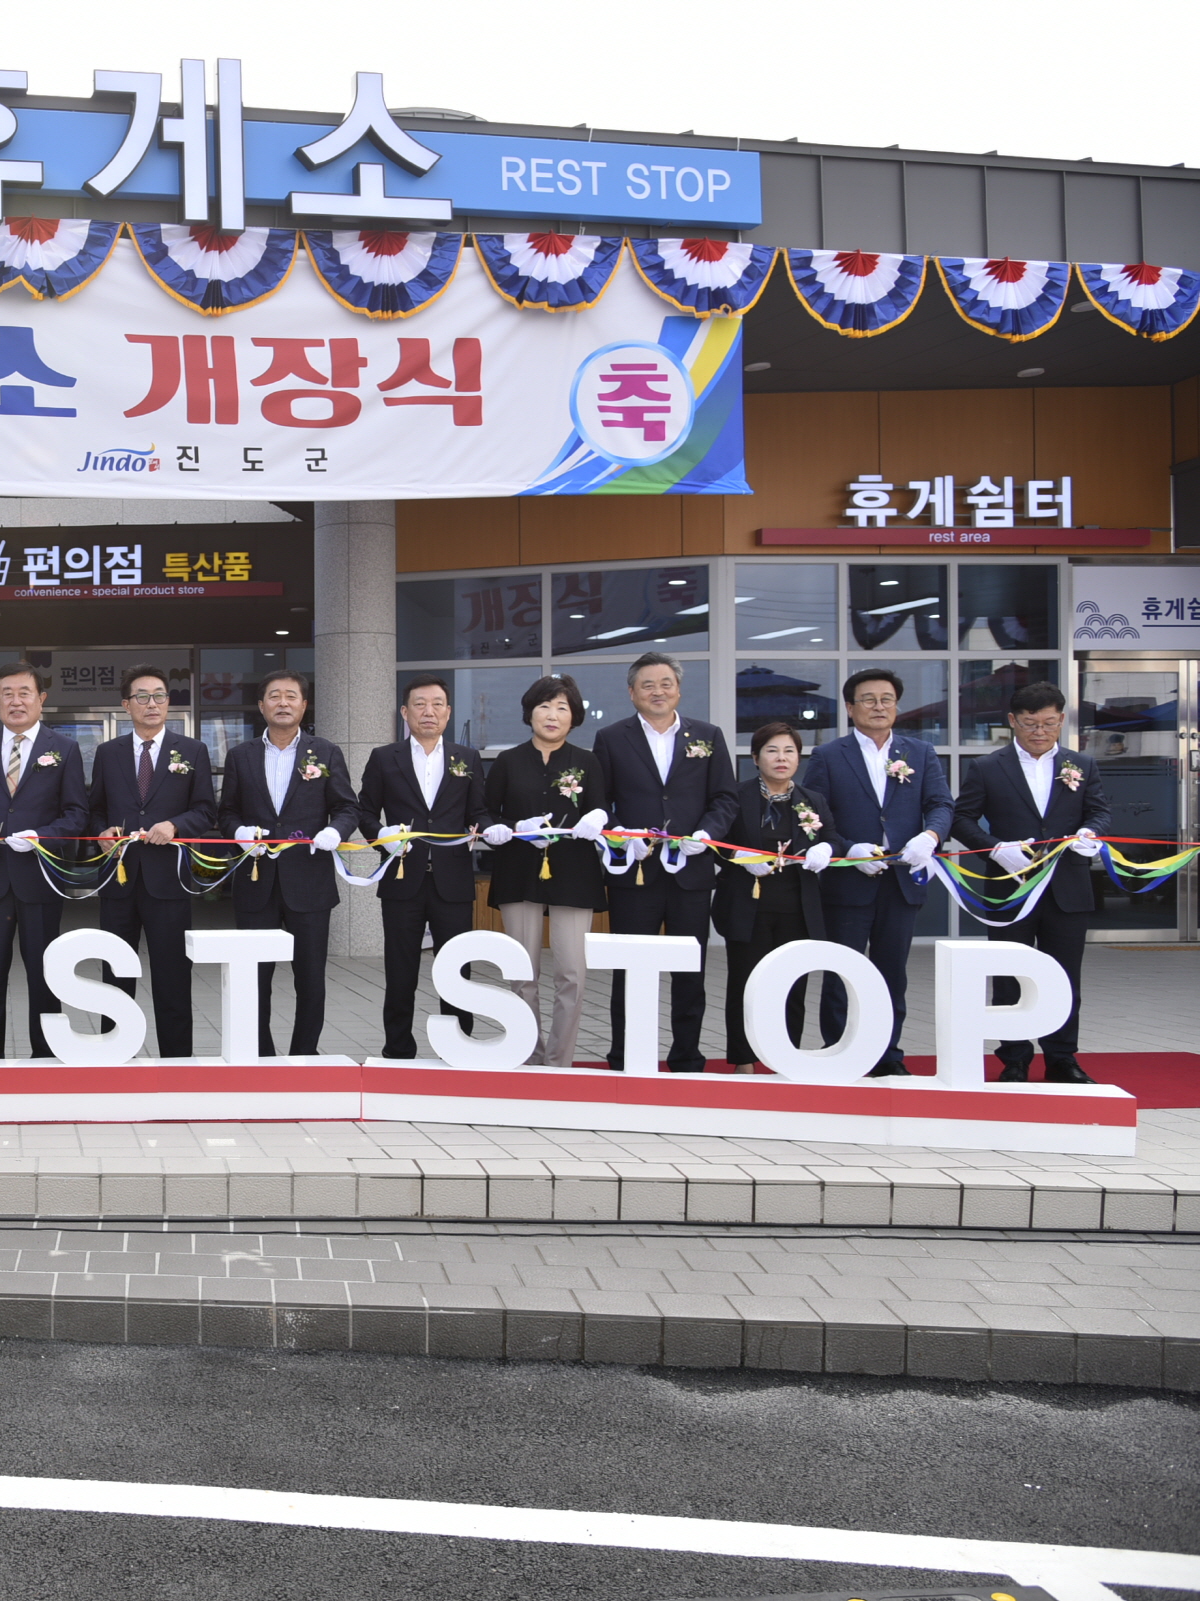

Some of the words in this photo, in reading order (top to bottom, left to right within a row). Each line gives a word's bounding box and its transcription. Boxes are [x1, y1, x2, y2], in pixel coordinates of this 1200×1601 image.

[501, 156, 607, 196] REST
[626, 163, 731, 203] STOP
[123, 334, 484, 430] 개장식
[597, 363, 672, 442] 축
[77, 451, 147, 472] Jindo
[845, 475, 1072, 528] 휴게쉼터
[929, 530, 955, 543] rest
[960, 532, 991, 544] area
[22, 544, 142, 586] 편의점
[162, 551, 252, 582] 특산품
[14, 587, 81, 597] convenience
[92, 586, 130, 597] special
[134, 585, 175, 597] product
[178, 585, 205, 595] store
[60, 666, 115, 686] 편의점
[426, 930, 1073, 1090] STOP
